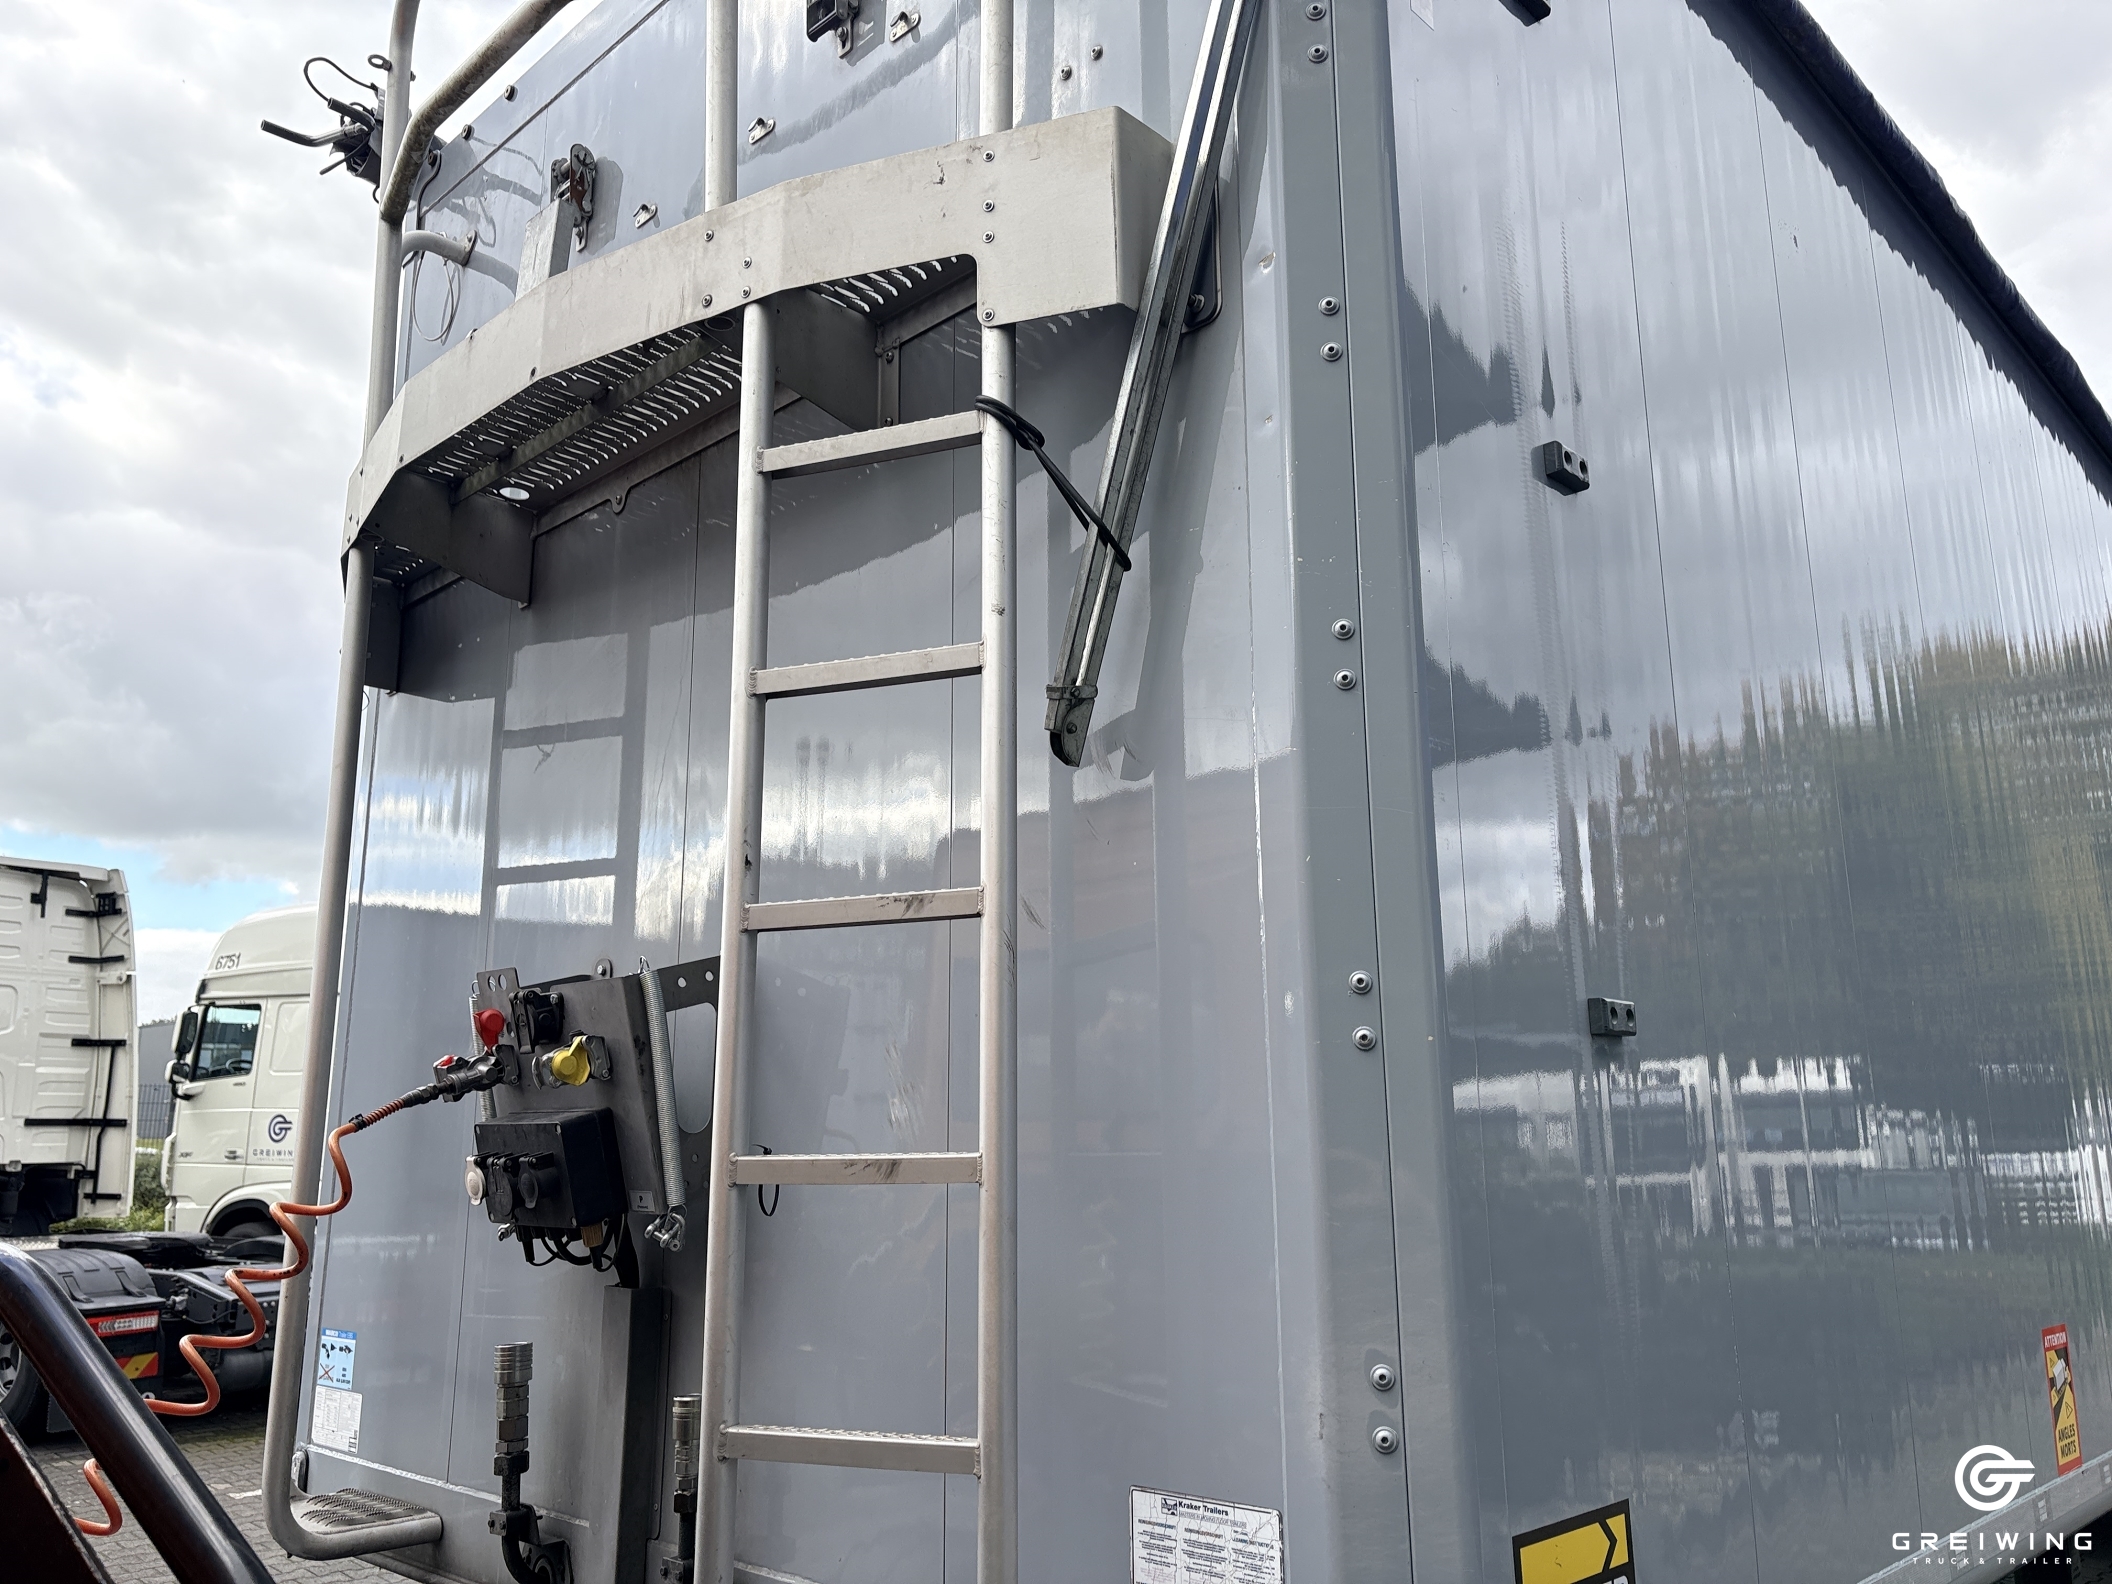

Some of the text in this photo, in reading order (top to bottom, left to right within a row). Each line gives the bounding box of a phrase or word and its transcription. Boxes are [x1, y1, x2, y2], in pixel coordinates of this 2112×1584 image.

[215, 952, 241, 970] 6751
[252, 1148, 294, 1157] GREIWIN
[2044, 1331, 2067, 1348] ATTENTION
[2058, 1423, 2075, 1442] ANGLES
[2060, 1440, 2077, 1459] MORTS
[1179, 1501, 1229, 1516] Kraker Trailers
